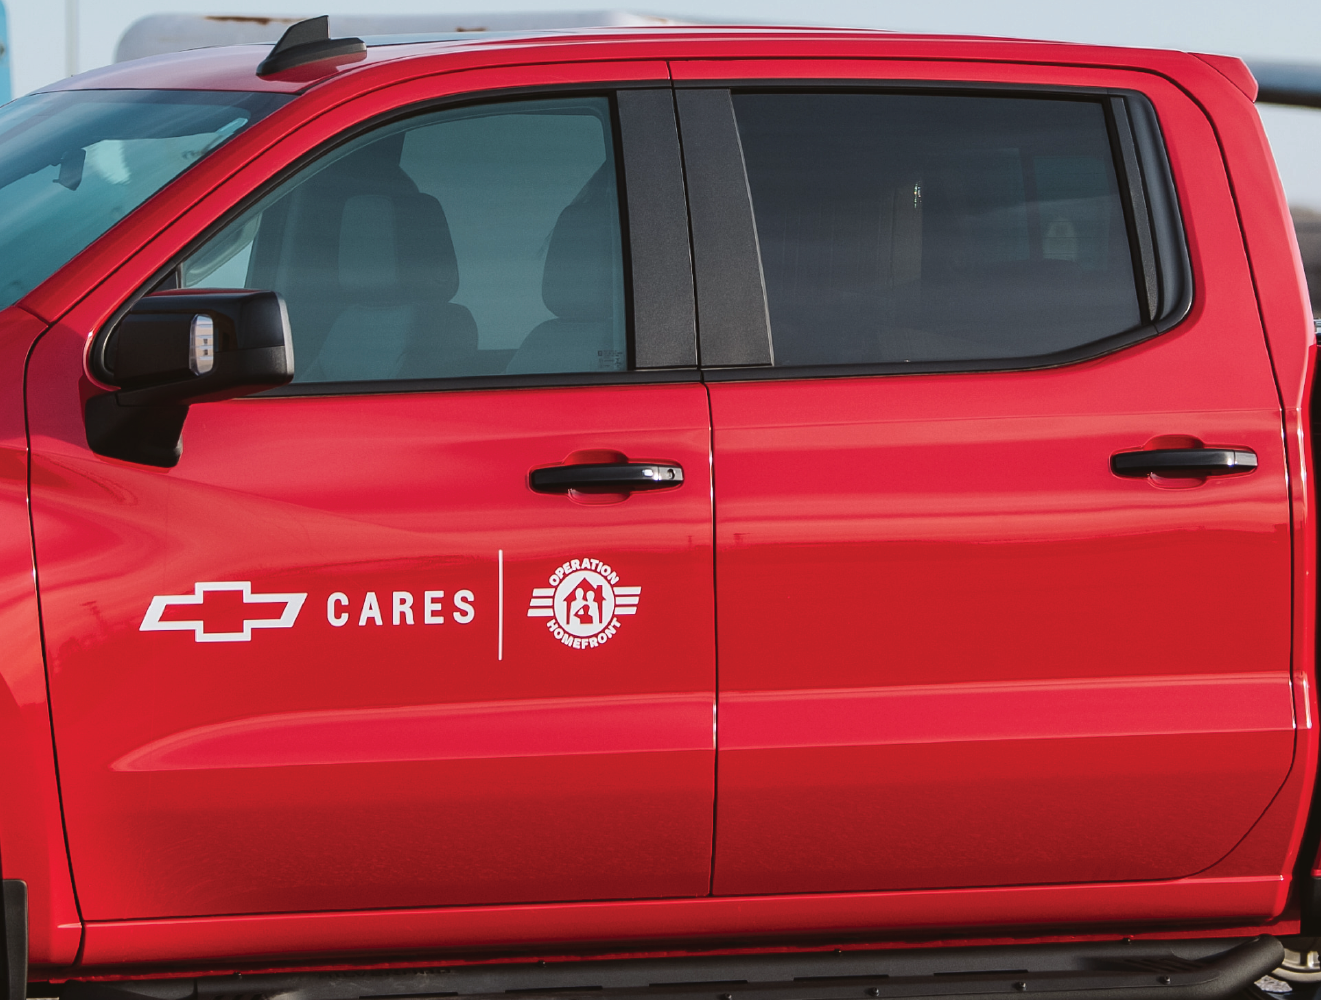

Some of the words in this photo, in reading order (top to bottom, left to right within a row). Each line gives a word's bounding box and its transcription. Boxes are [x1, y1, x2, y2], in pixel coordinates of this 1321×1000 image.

[549, 558, 620, 586] OPERATION
[327, 589, 476, 627] CARES
[546, 617, 621, 649] HOMEFRONT
